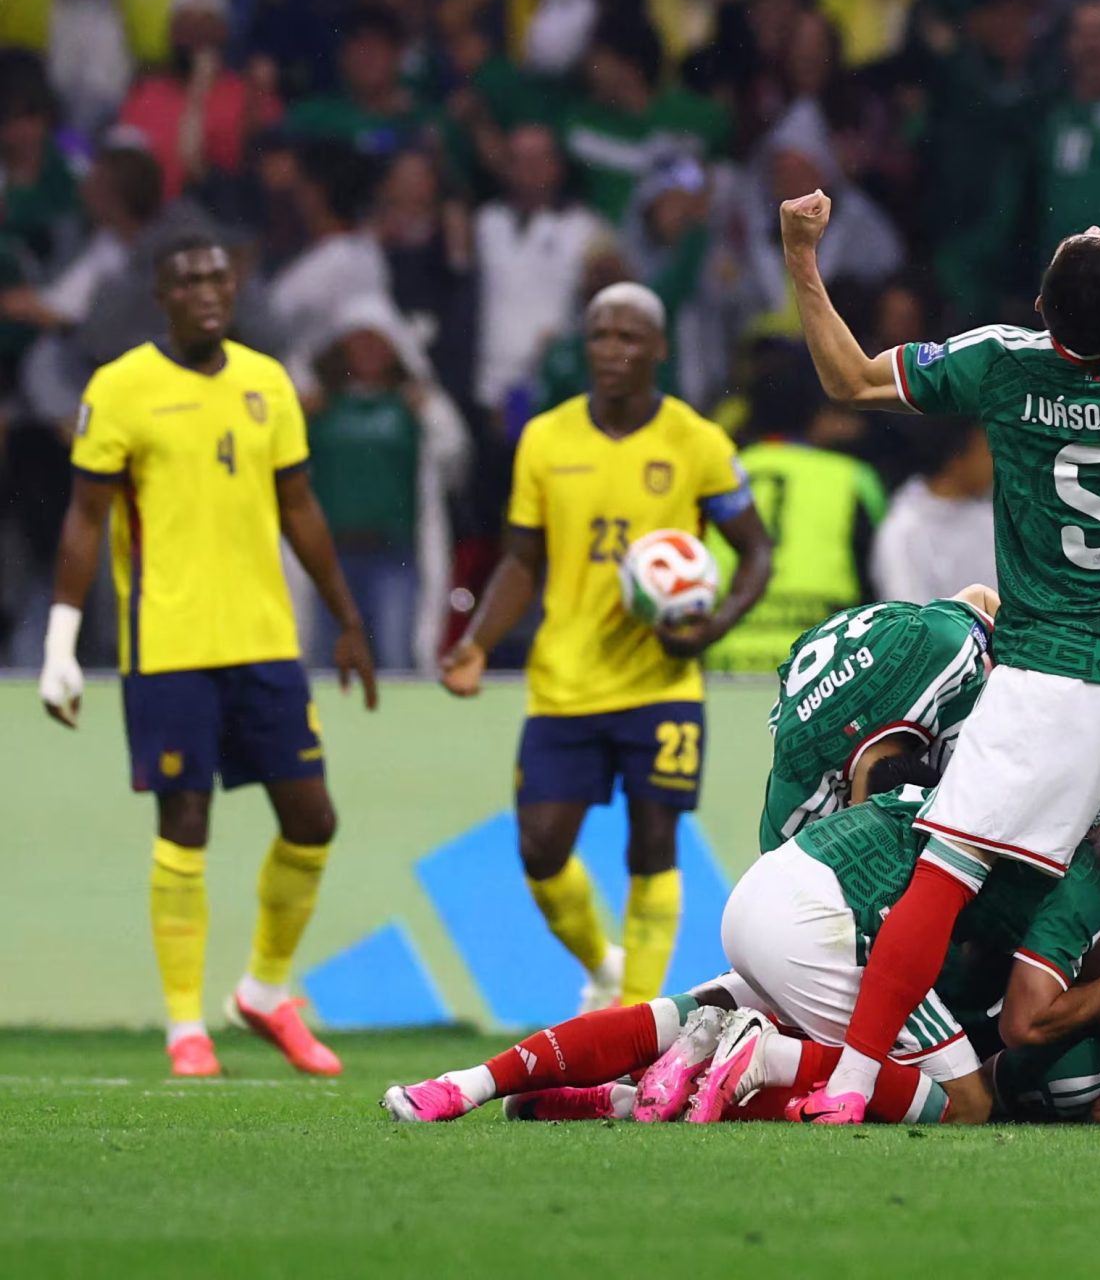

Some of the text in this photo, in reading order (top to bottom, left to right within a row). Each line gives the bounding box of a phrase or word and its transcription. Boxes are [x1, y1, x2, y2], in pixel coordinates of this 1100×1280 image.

[217, 430, 236, 475] 4
[589, 516, 631, 564] 23
[796, 646, 874, 722] G.MORA
[655, 720, 701, 775] 23
